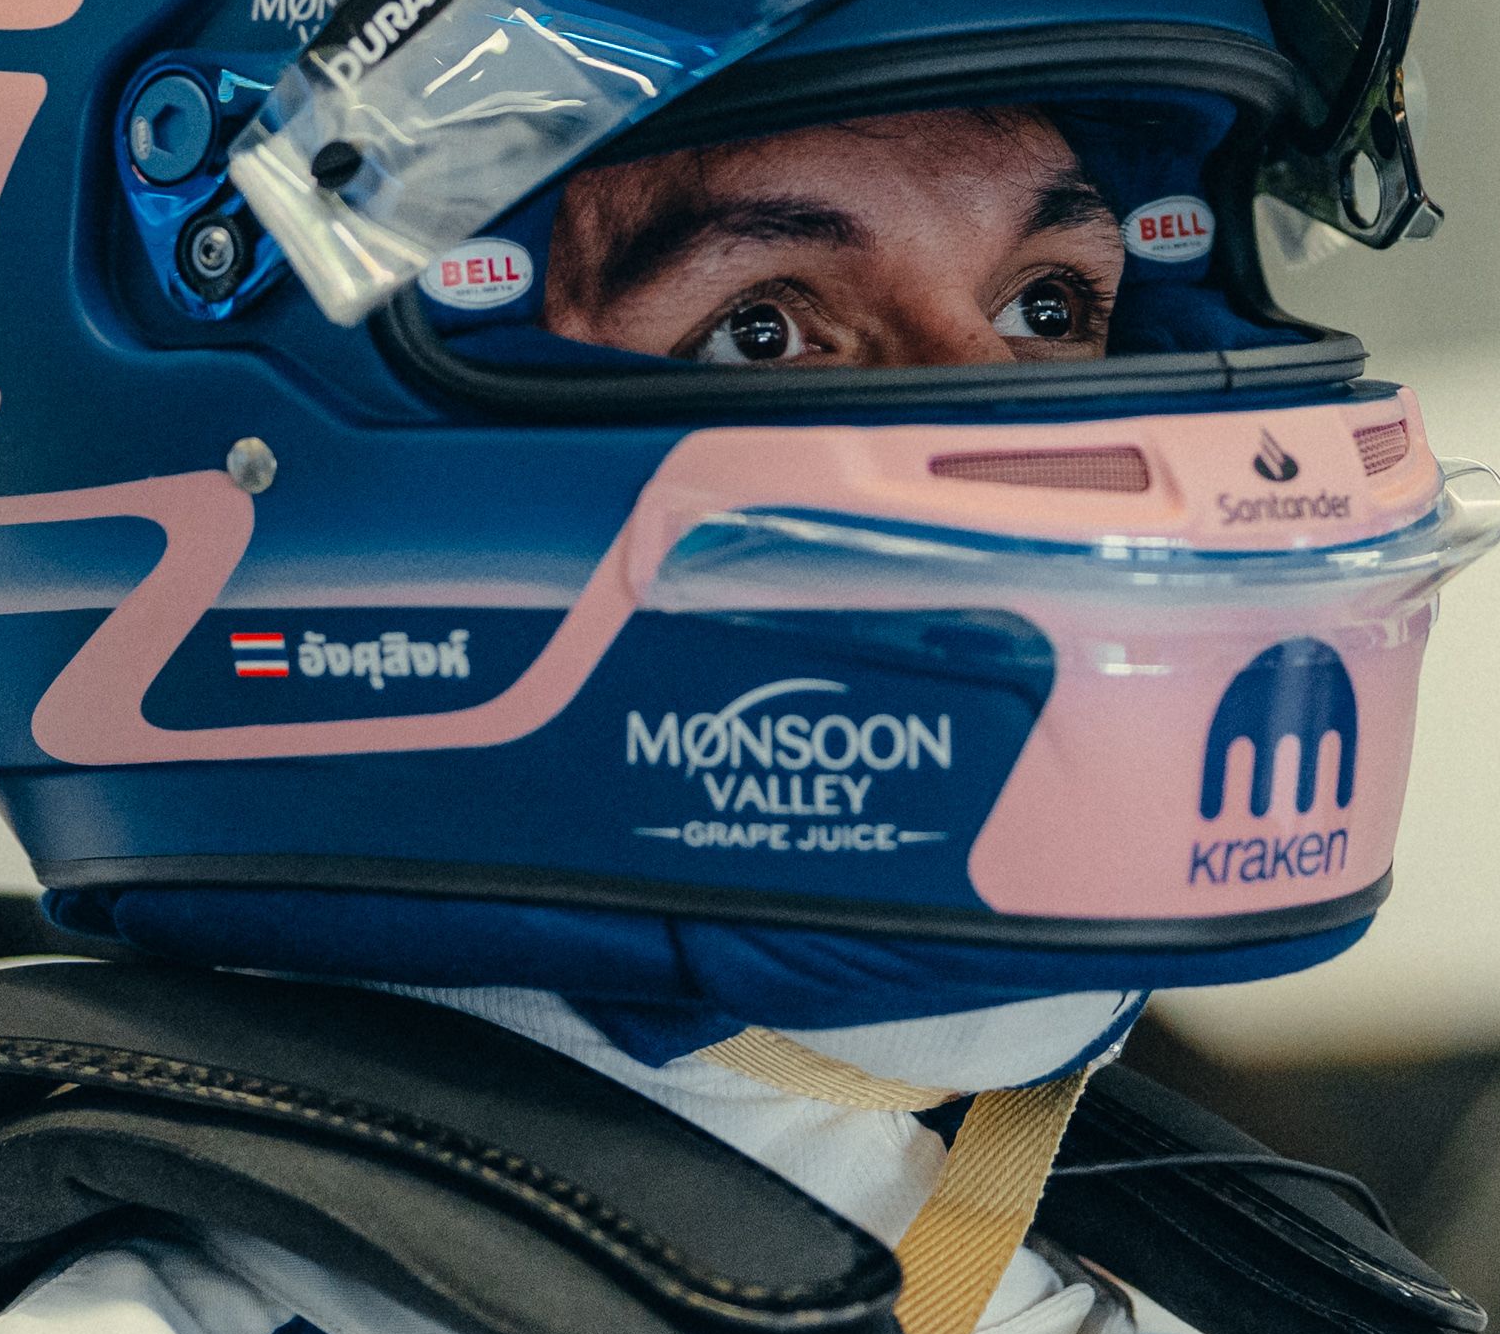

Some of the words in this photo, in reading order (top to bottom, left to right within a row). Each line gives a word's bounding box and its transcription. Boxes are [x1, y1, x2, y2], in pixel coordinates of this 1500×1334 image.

[1140, 212, 1209, 241] BELL
[441, 256, 520, 287] BELL
[1217, 489, 1351, 526] Santander
[703, 772, 873, 815] VALLEY
[681, 820, 791, 851] GRAPE
[796, 823, 898, 852] JUICE
